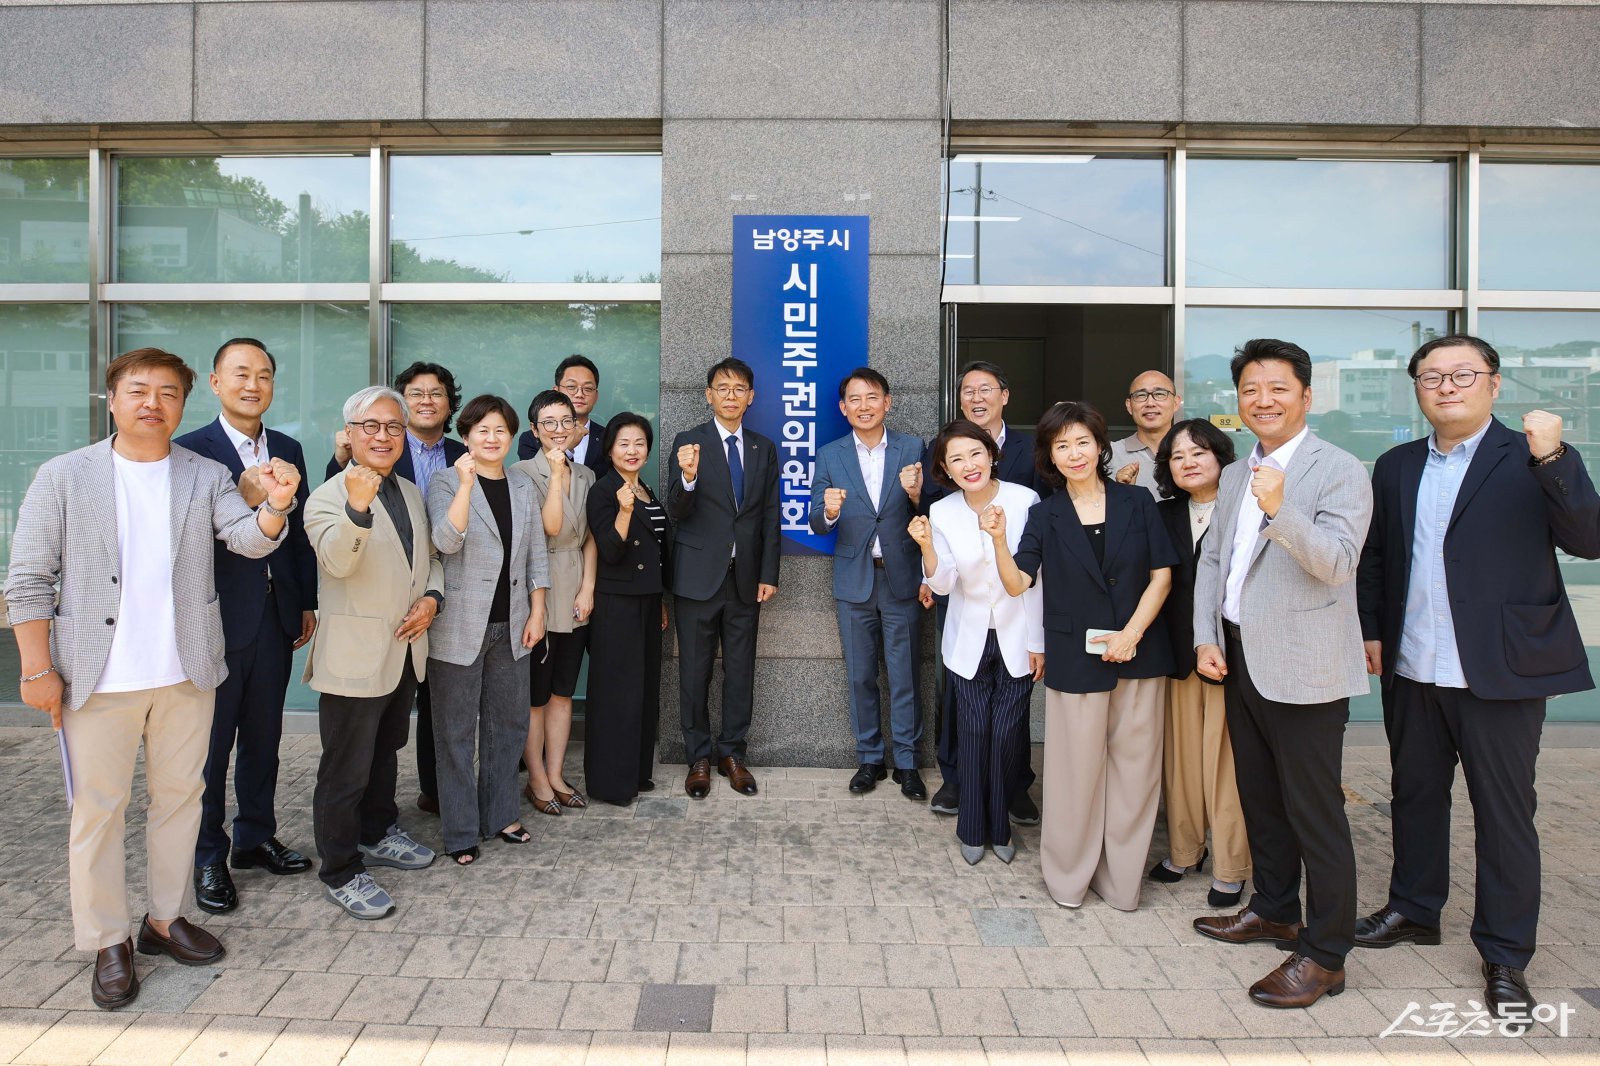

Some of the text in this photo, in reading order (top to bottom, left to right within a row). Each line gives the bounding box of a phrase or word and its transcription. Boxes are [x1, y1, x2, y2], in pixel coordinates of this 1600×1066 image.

[752, 228, 850, 252] 남양주시
[781, 263, 818, 536] 시민주권위원회
[389, 849, 400, 858] N
[342, 895, 353, 904] N
